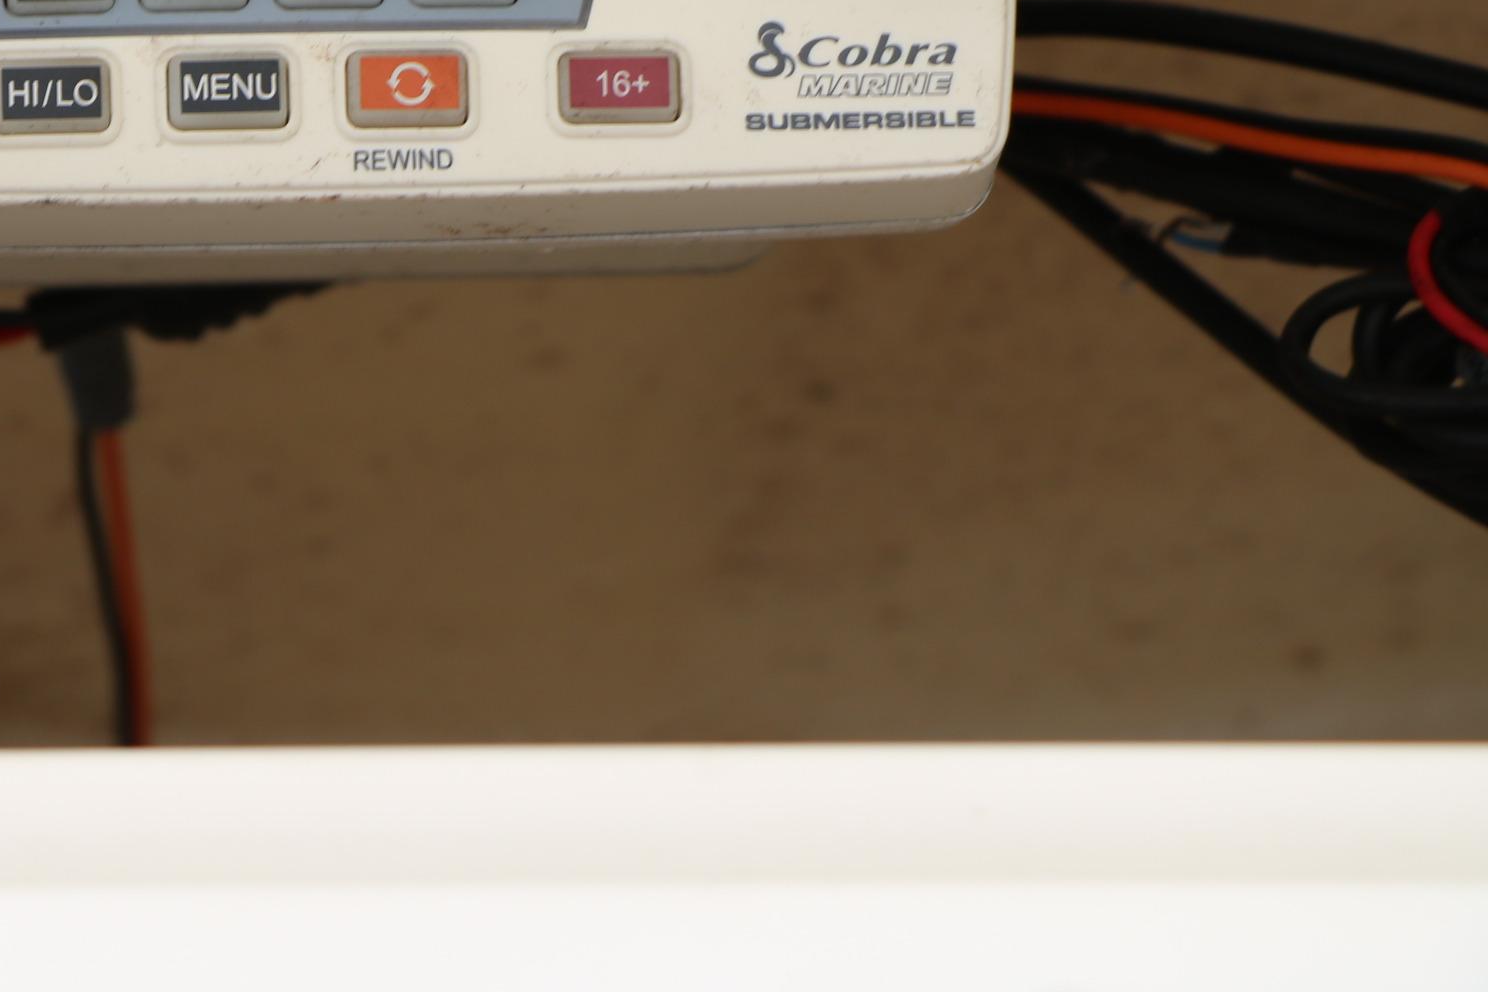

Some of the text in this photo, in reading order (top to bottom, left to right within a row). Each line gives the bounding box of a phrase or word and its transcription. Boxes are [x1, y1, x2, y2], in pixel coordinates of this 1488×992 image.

[798, 32, 958, 68] Cobra
[7, 78, 99, 108] HI/LO
[181, 71, 278, 101] MENU
[596, 69, 650, 98] 16+
[796, 72, 954, 98] MARINE
[745, 110, 976, 131] SUBMERSIBLE
[353, 148, 454, 172] REWIND
